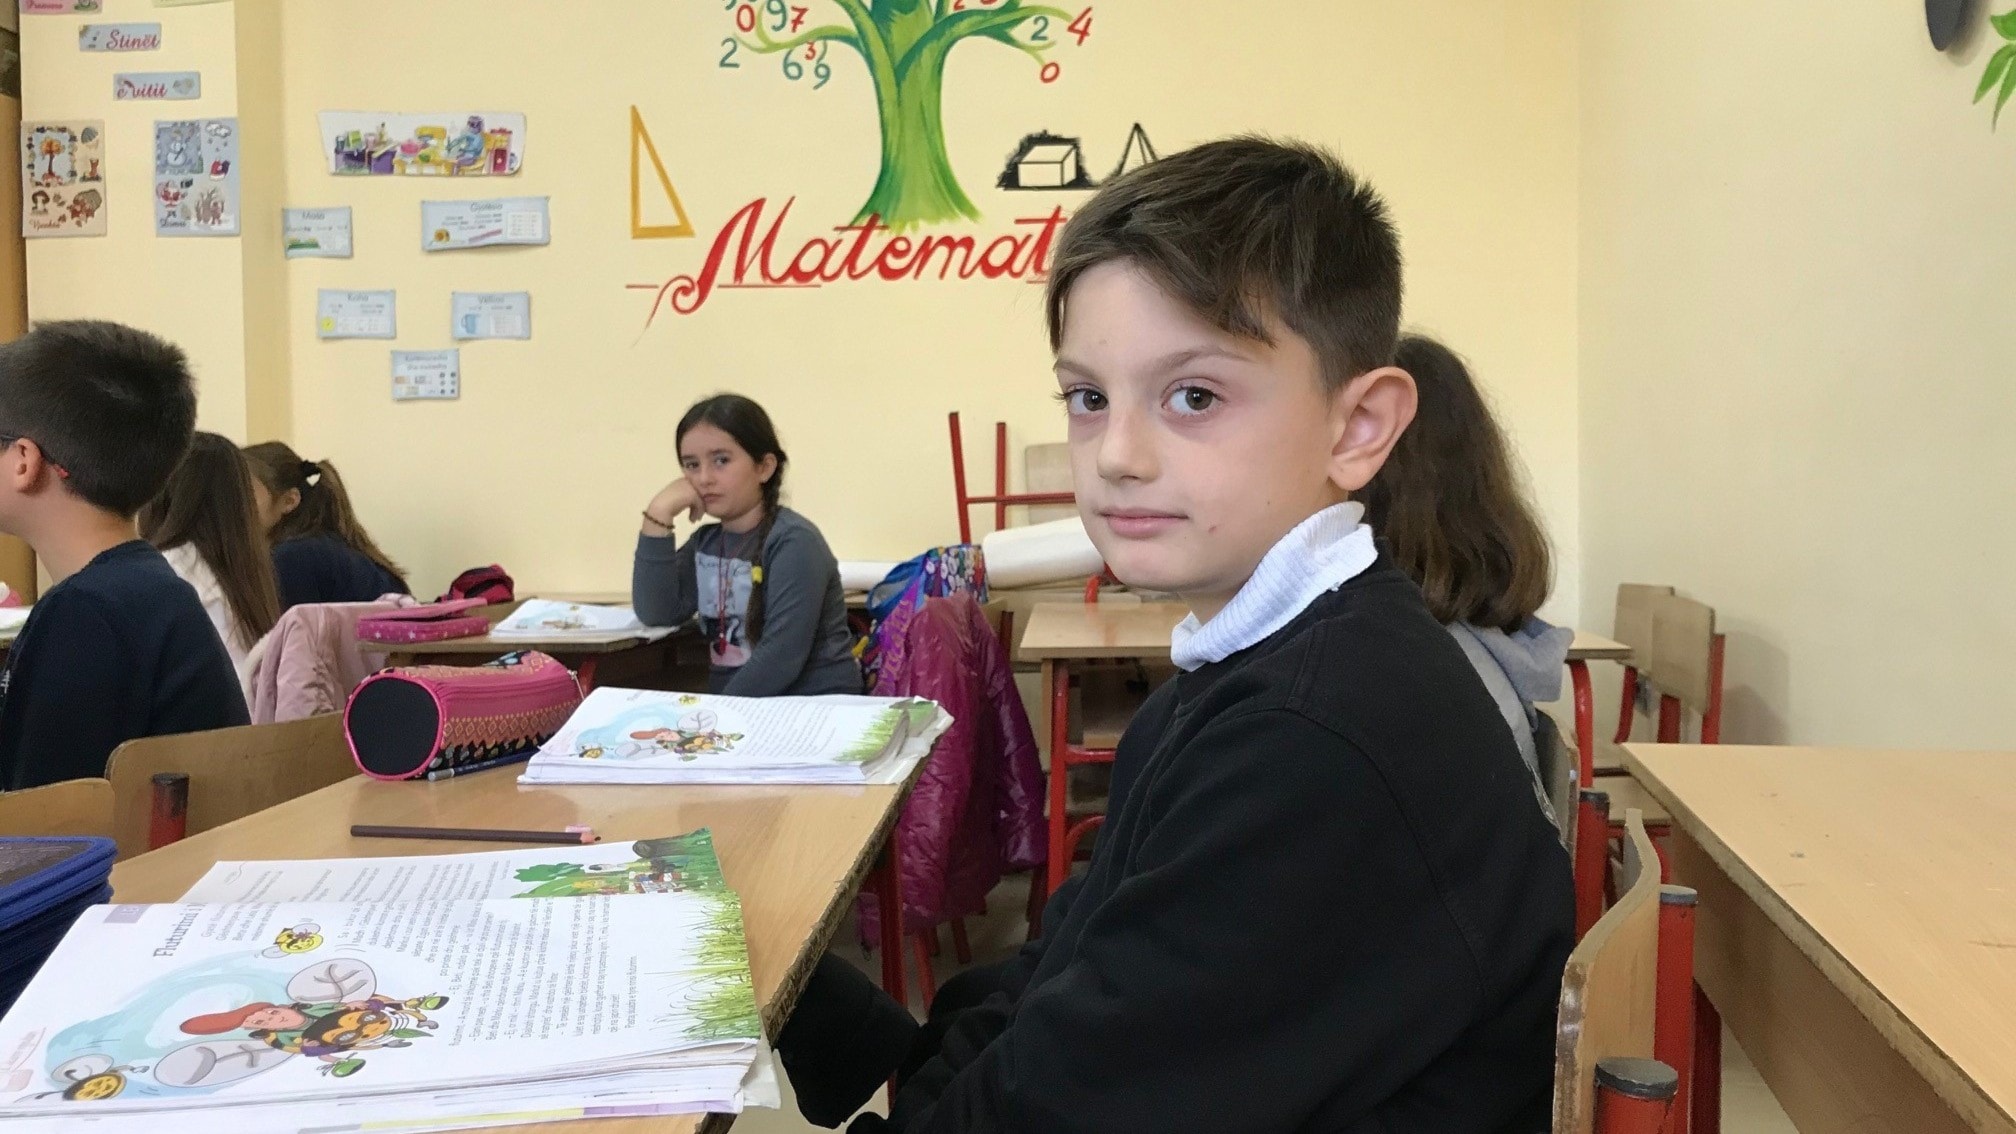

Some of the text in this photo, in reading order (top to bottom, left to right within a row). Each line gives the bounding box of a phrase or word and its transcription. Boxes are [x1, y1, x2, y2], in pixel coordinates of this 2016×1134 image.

[736, 4, 756, 32] 0
[766, 0, 787, 31] 9
[791, 6, 809, 33] 7
[1031, 16, 1049, 41] 2
[1067, 7, 1093, 46] 4
[719, 37, 740, 68] 2
[782, 49, 803, 81] 6
